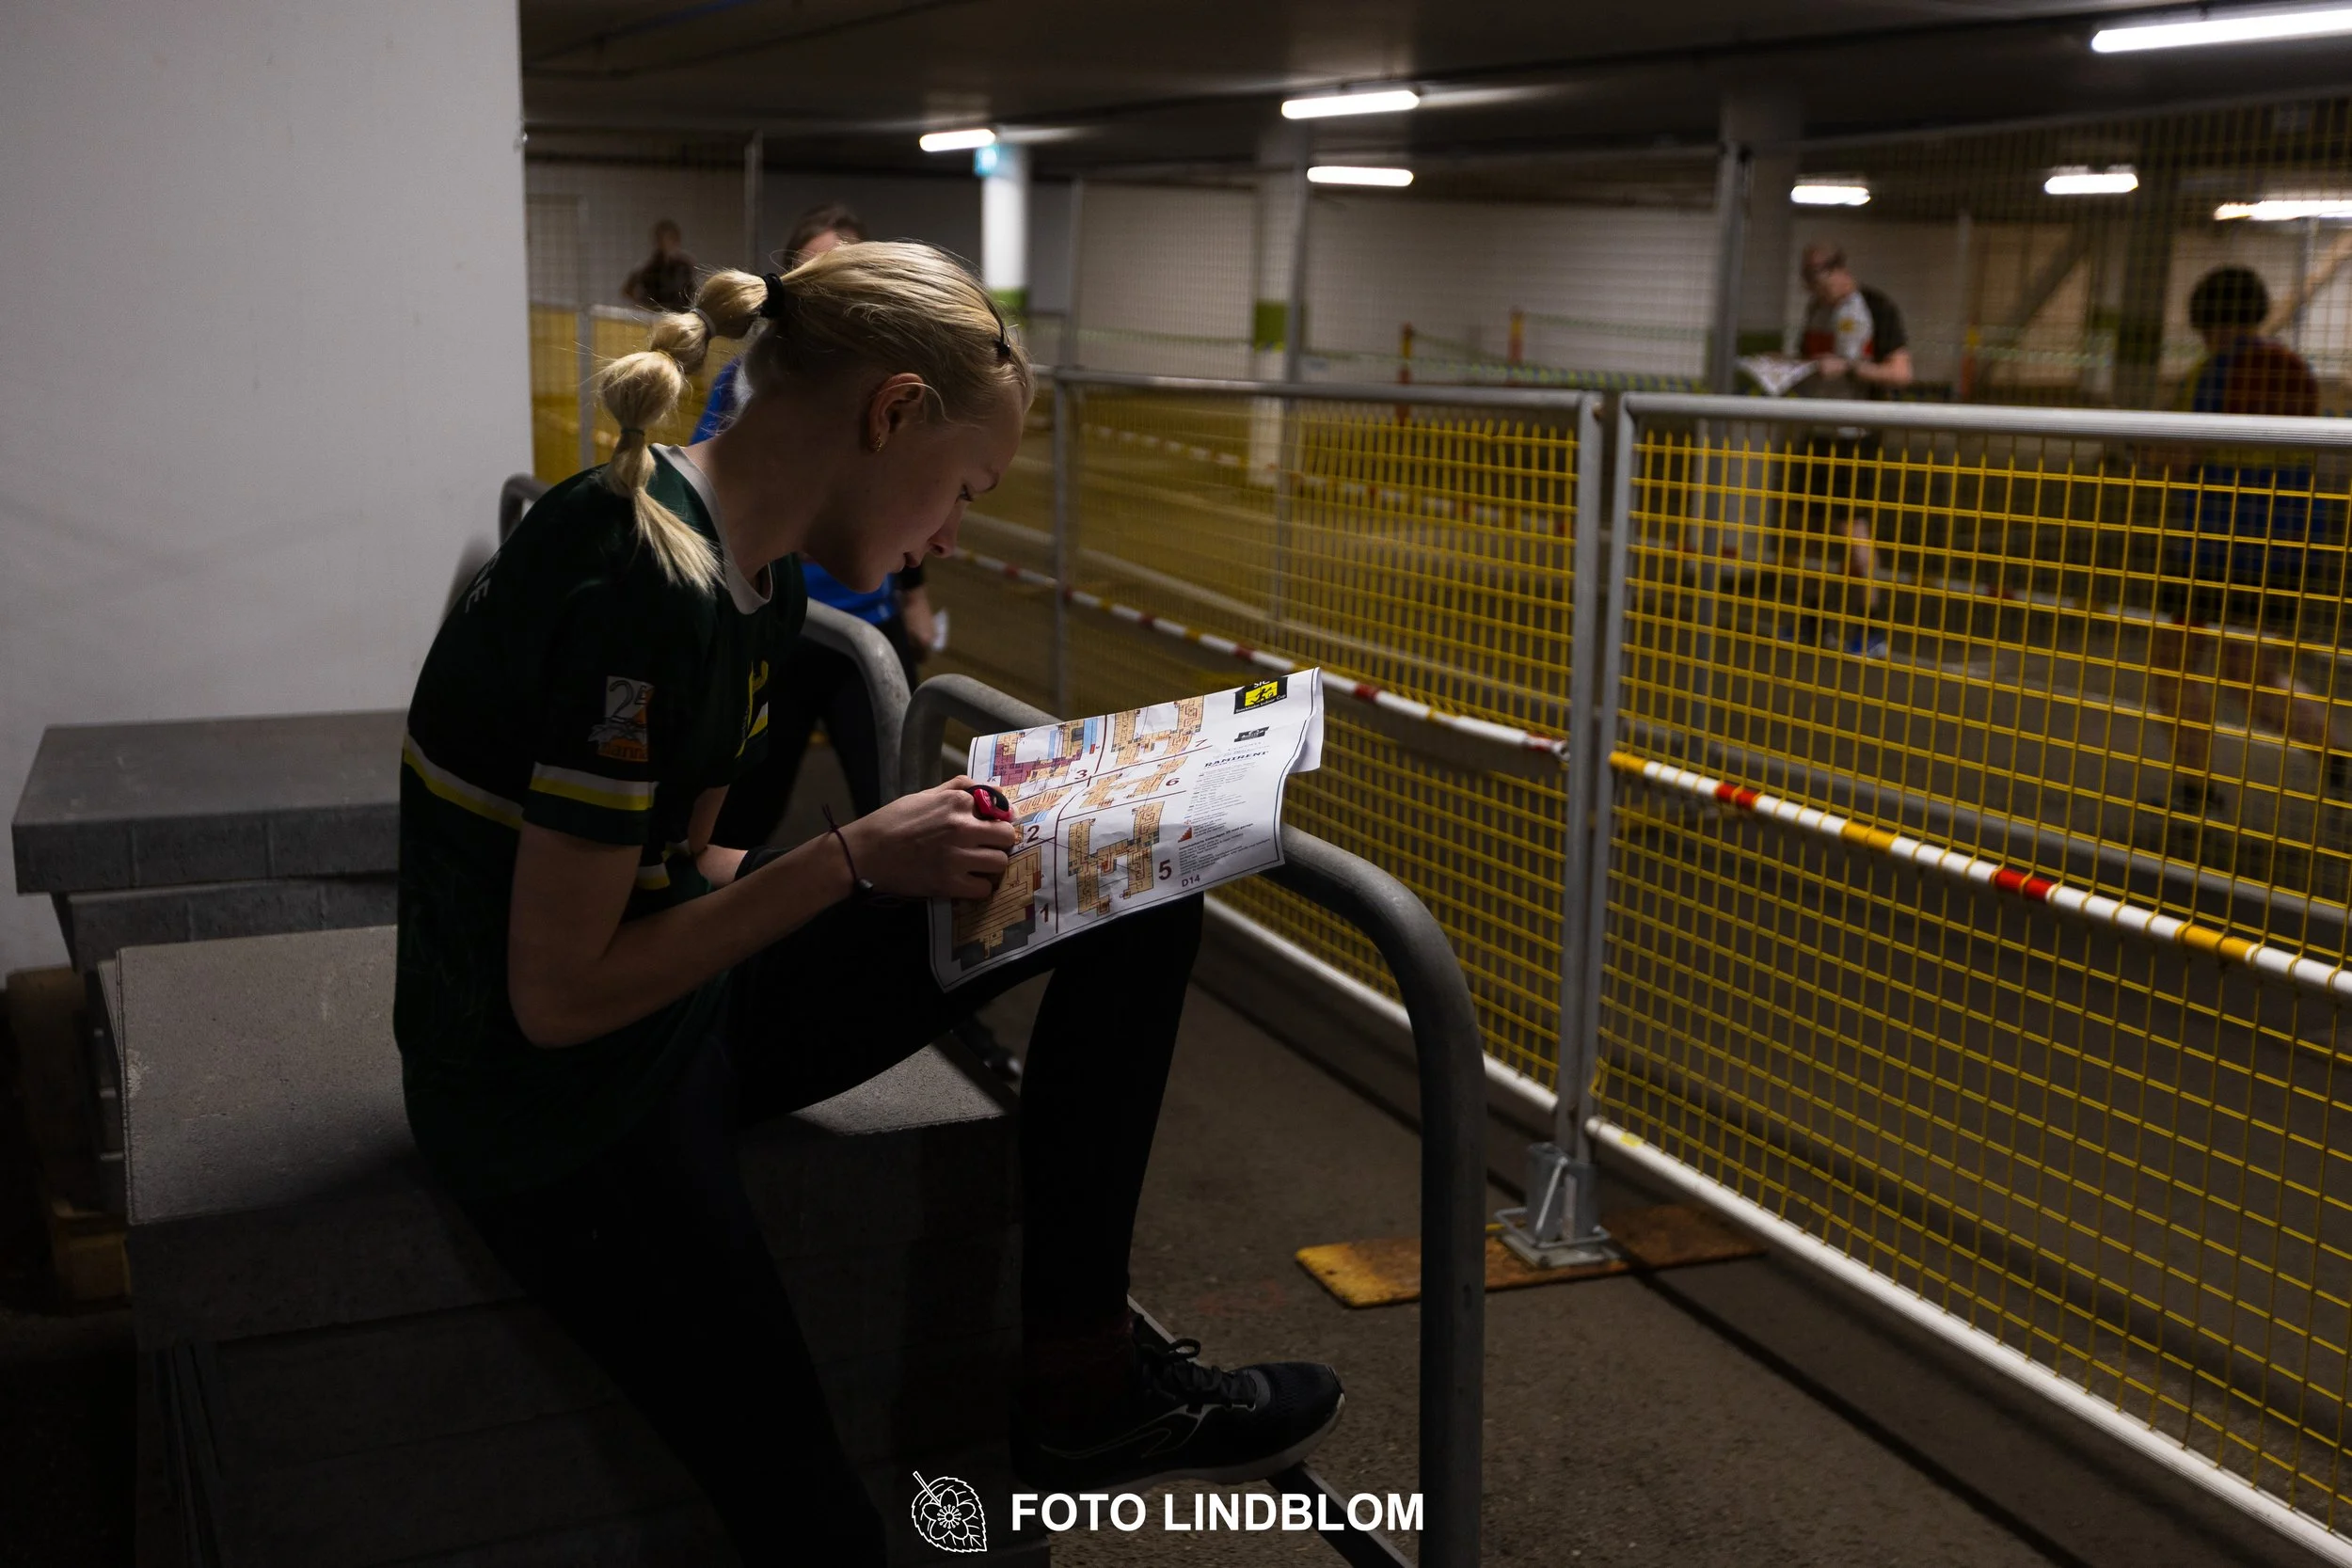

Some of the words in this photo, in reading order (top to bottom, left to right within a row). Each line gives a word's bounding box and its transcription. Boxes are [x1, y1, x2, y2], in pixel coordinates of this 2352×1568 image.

[1195, 738, 1208, 748] 7
[1204, 750, 1270, 768] RAMIRENT
[1074, 768, 1088, 780] 3
[1166, 777, 1181, 786] 6
[1027, 825, 1041, 843] 2
[1158, 859, 1172, 881] 5
[1182, 874, 1200, 888] D14
[1040, 903, 1049, 923] 1
